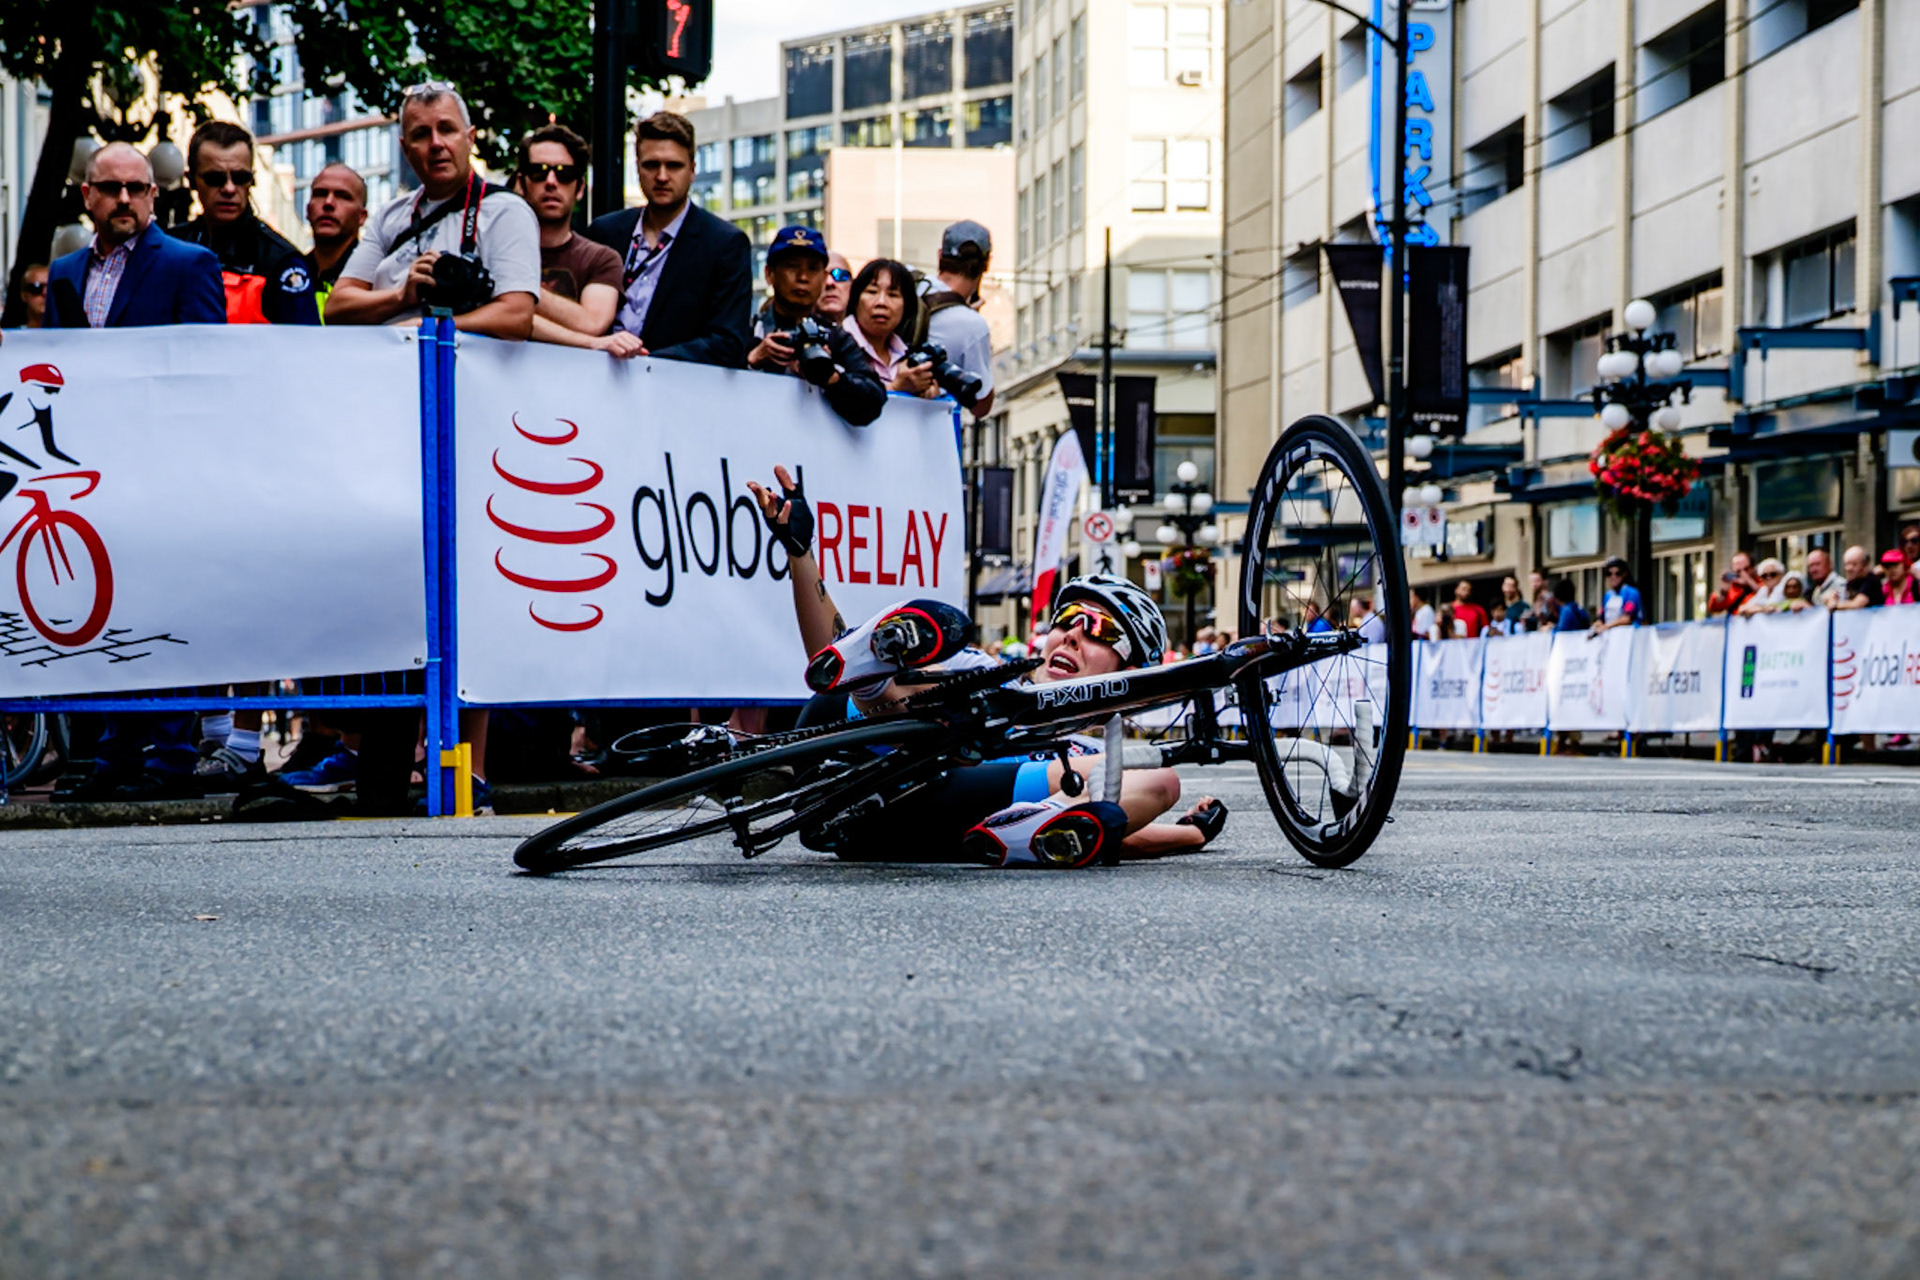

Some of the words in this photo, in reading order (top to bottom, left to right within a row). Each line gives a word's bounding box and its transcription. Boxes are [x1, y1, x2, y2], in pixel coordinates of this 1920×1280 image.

[1404, 23, 1434, 207] PARK
[632, 452, 803, 607] globa
[818, 501, 948, 588] RELAY
